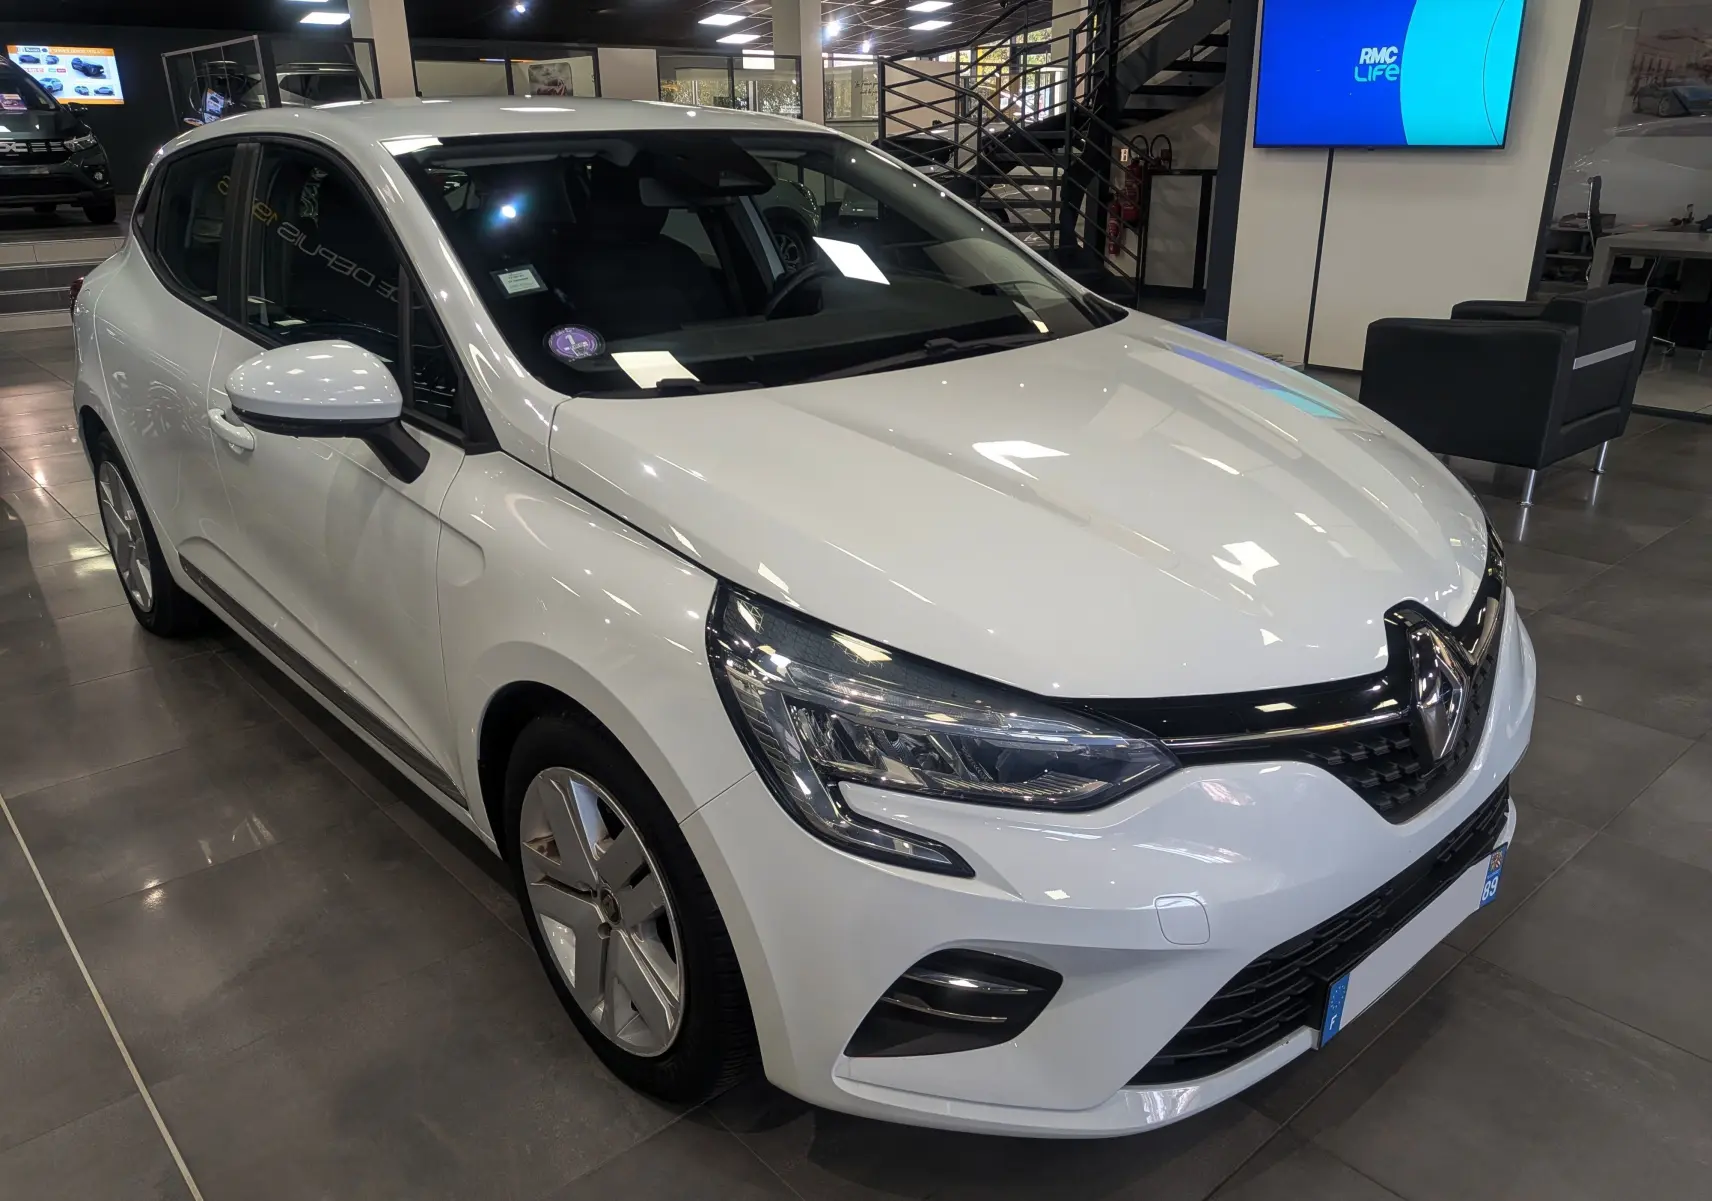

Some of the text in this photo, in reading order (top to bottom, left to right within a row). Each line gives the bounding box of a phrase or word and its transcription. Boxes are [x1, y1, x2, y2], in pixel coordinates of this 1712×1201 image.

[1359, 46, 1398, 64] RMC
[1483, 876, 1498, 900] 89
[1329, 1014, 1338, 1031] F
